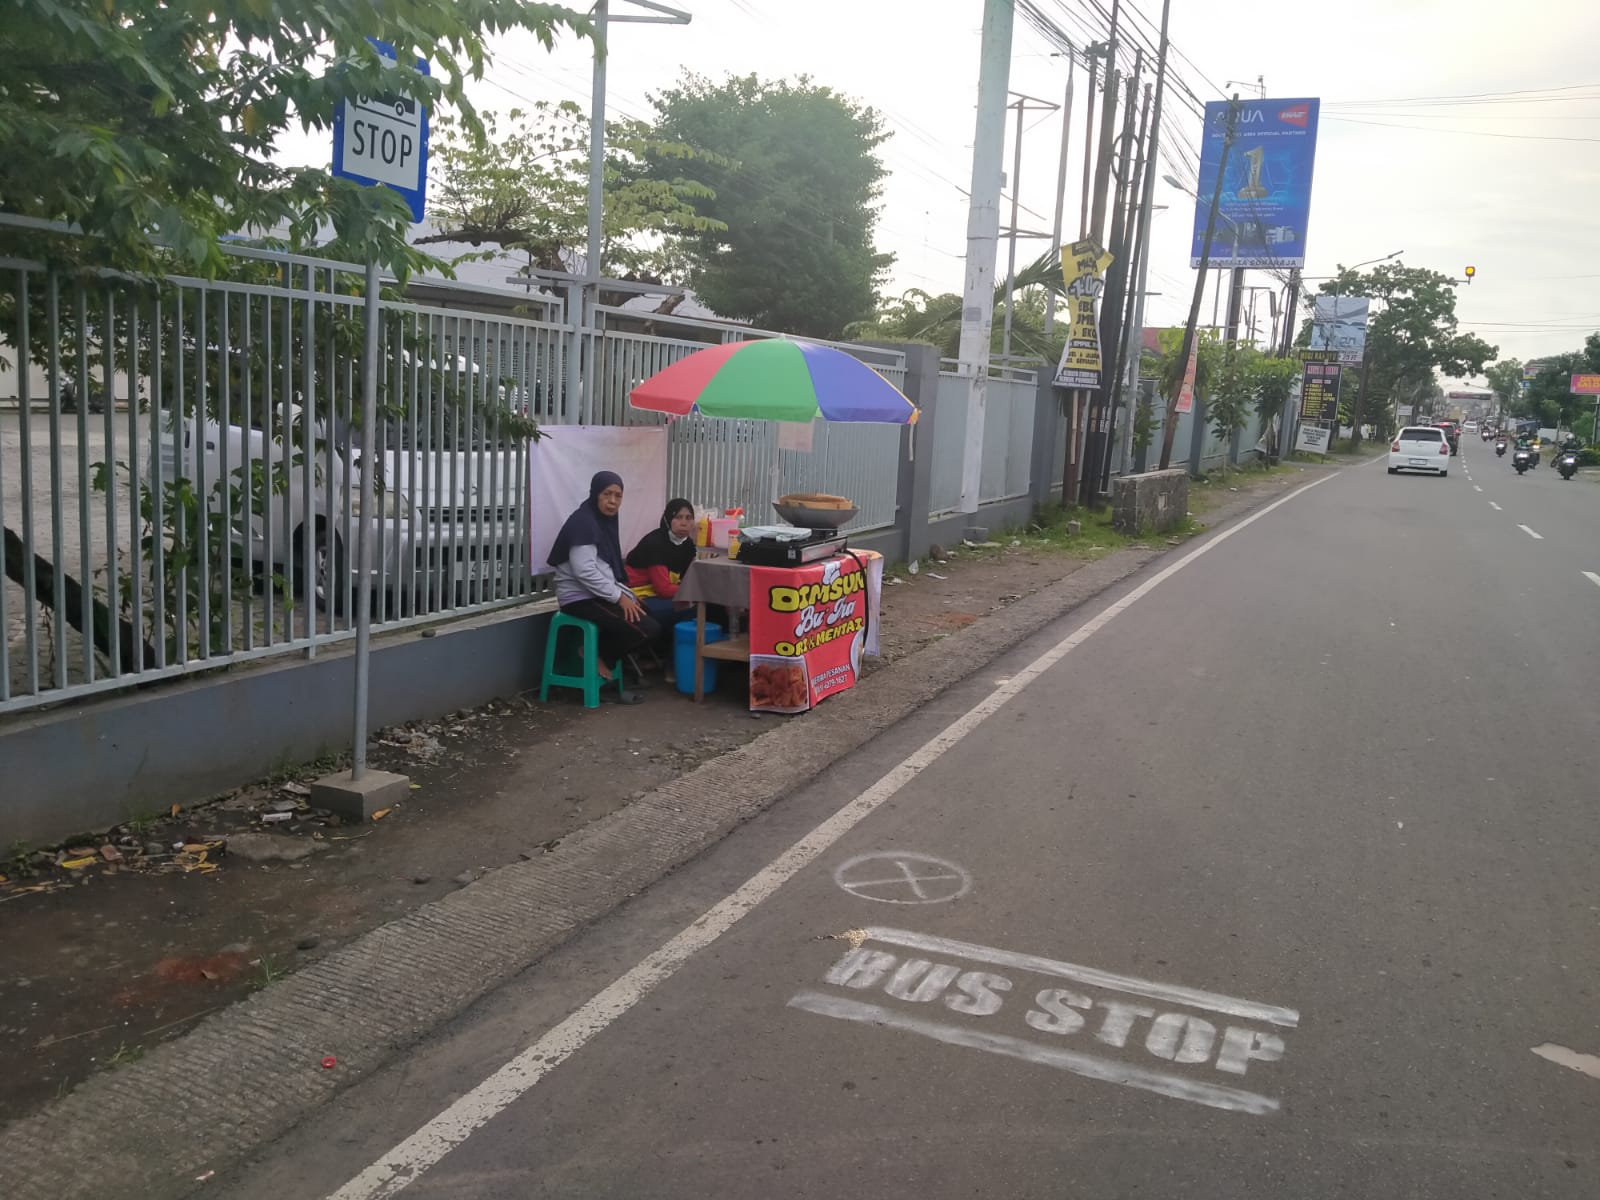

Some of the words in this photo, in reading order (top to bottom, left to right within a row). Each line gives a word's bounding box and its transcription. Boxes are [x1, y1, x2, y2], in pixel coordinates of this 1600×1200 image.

[352, 119, 413, 168] STOP
[775, 637, 809, 657] ORI
[815, 617, 863, 647] MENTAI
[822, 948, 1013, 1016] BUS
[1025, 987, 1285, 1075] STOP
